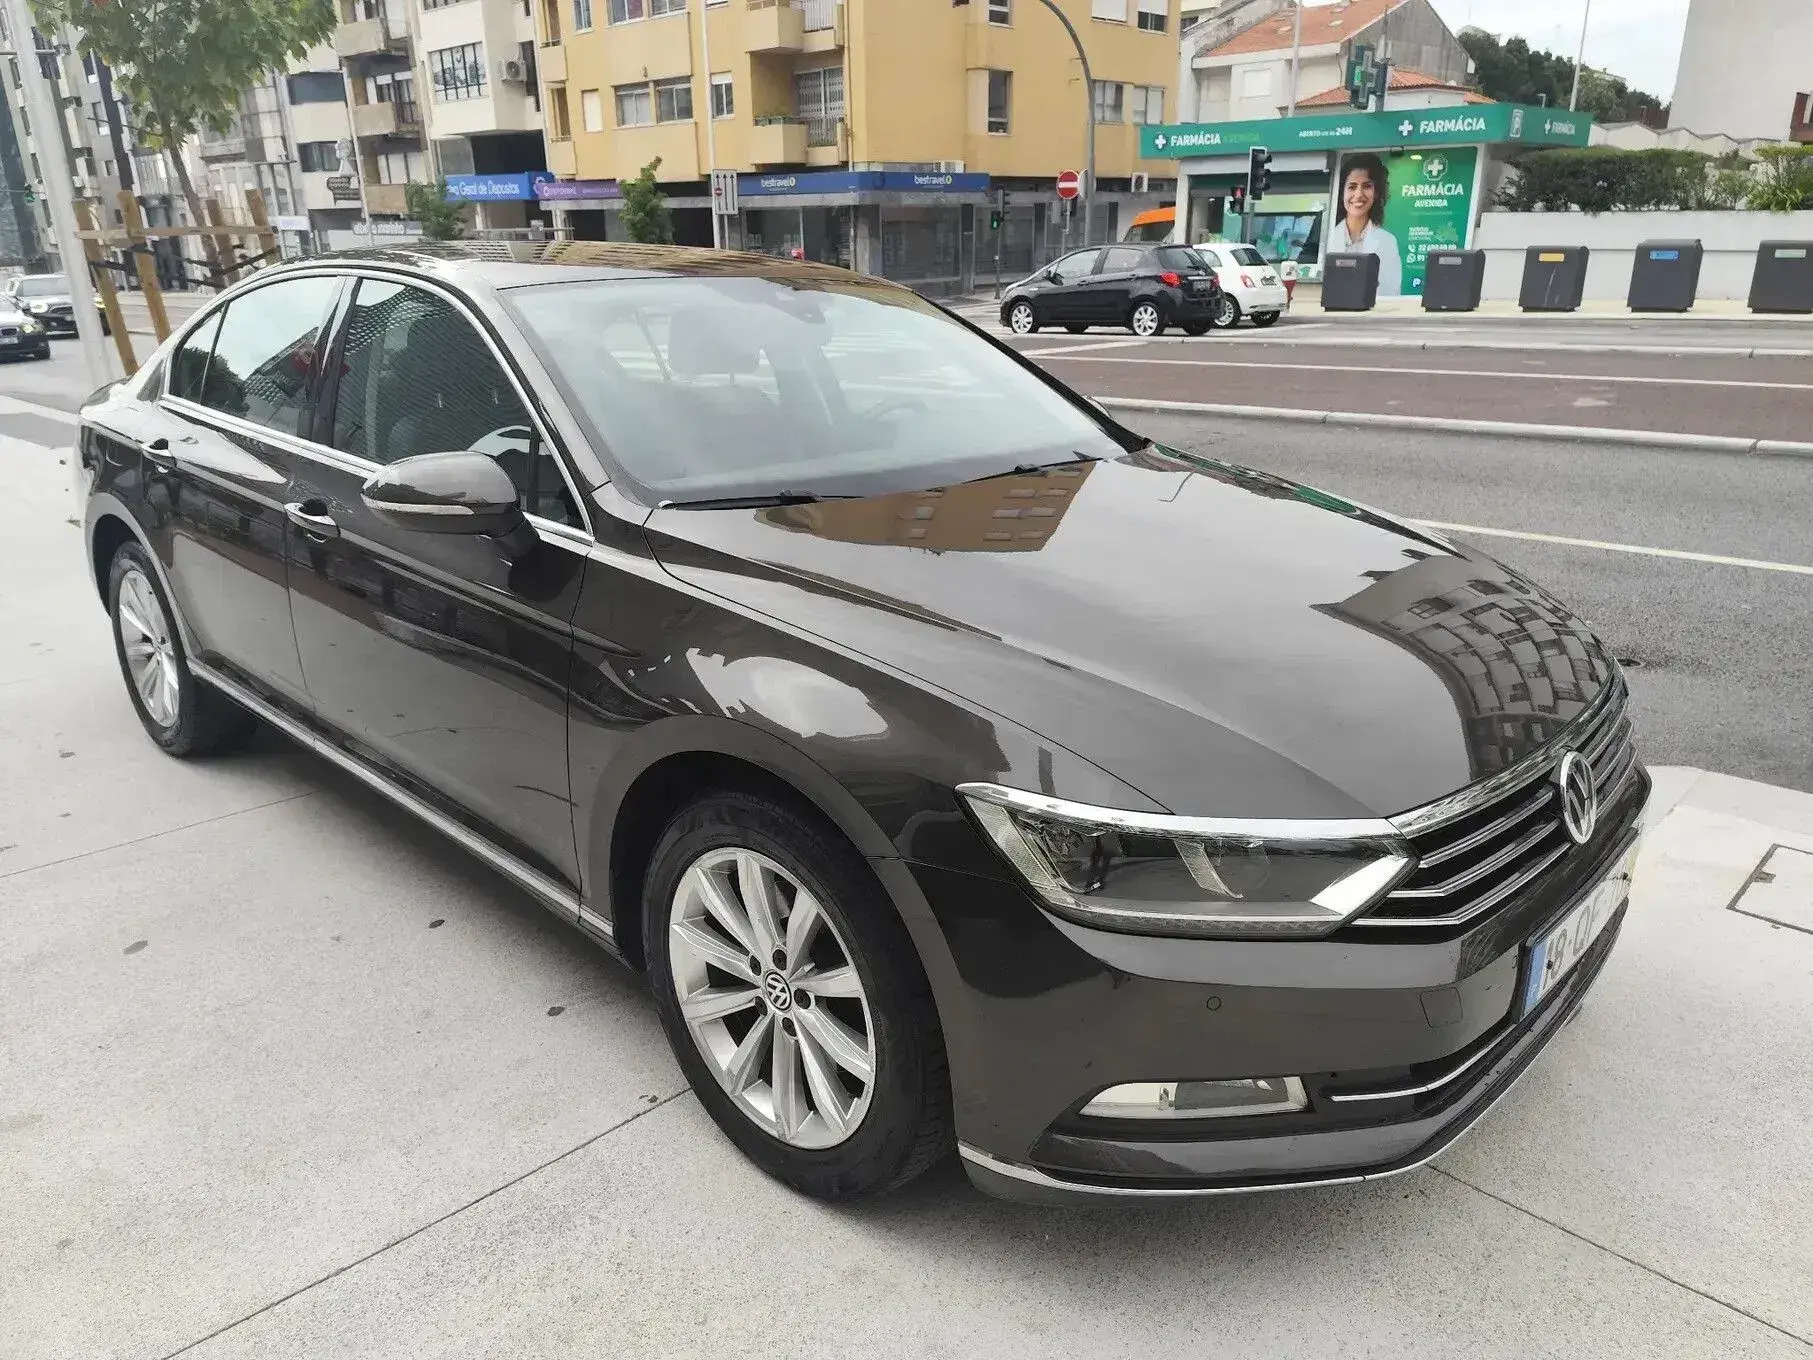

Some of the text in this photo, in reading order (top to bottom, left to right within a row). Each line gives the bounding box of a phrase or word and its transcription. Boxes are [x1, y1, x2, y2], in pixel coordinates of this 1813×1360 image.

[1419, 115, 1486, 134] FARMÁCIA
[1170, 131, 1222, 147] FARMÁCIA
[914, 175, 946, 185] bestravel
[1402, 183, 1464, 197] FARMÁCIA
[1414, 199, 1448, 208] AVENIDA
